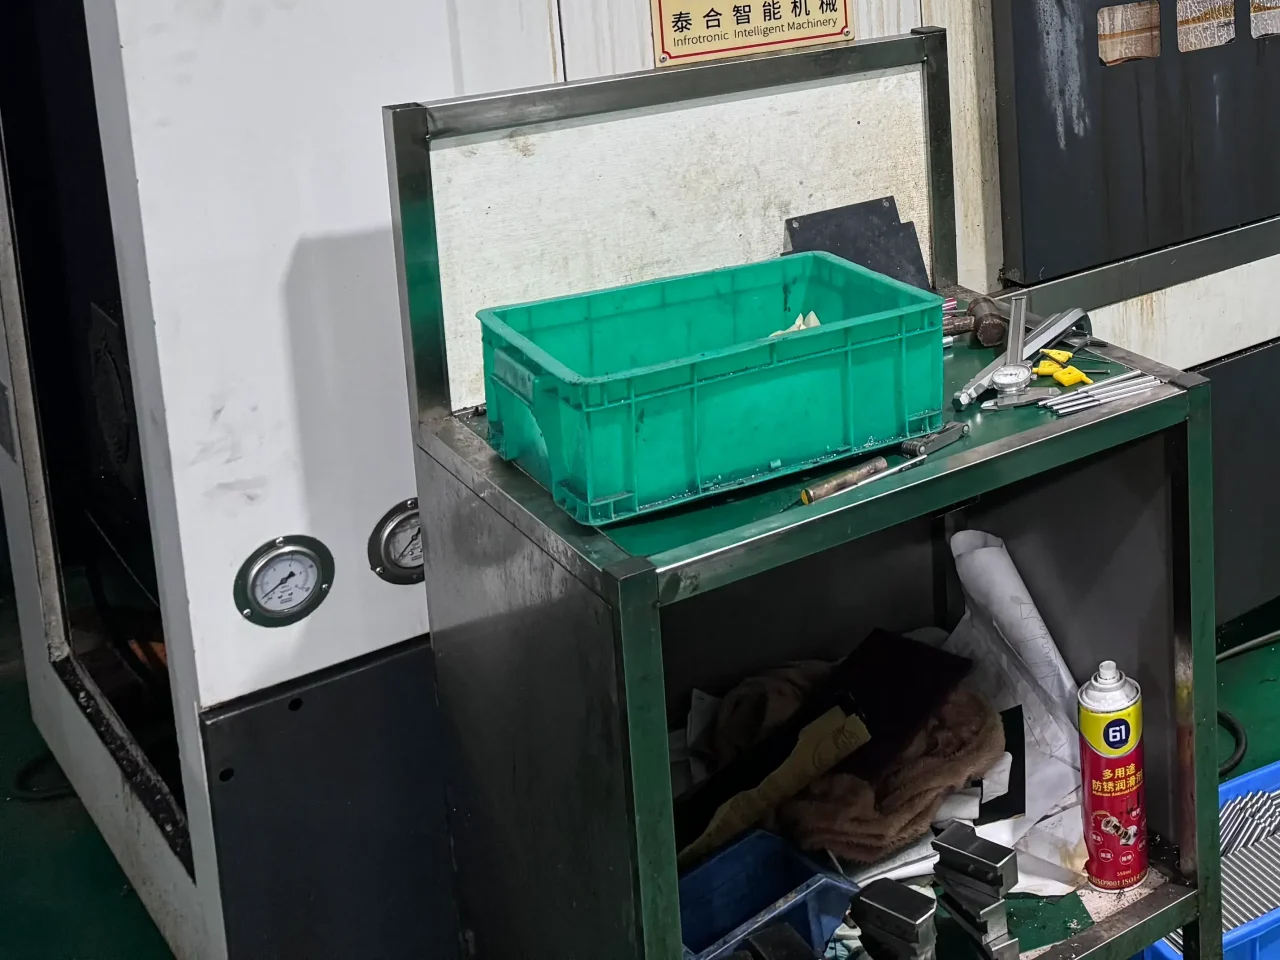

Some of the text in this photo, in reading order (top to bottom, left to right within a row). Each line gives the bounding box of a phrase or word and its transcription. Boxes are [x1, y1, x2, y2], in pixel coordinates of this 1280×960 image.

[672, 15, 839, 48] Infrotronic Intelligent Machinery
[1108, 724, 1127, 743] 61
[1092, 768, 1144, 792] 防锈润滑剂
[1102, 763, 1136, 780] 多用途
